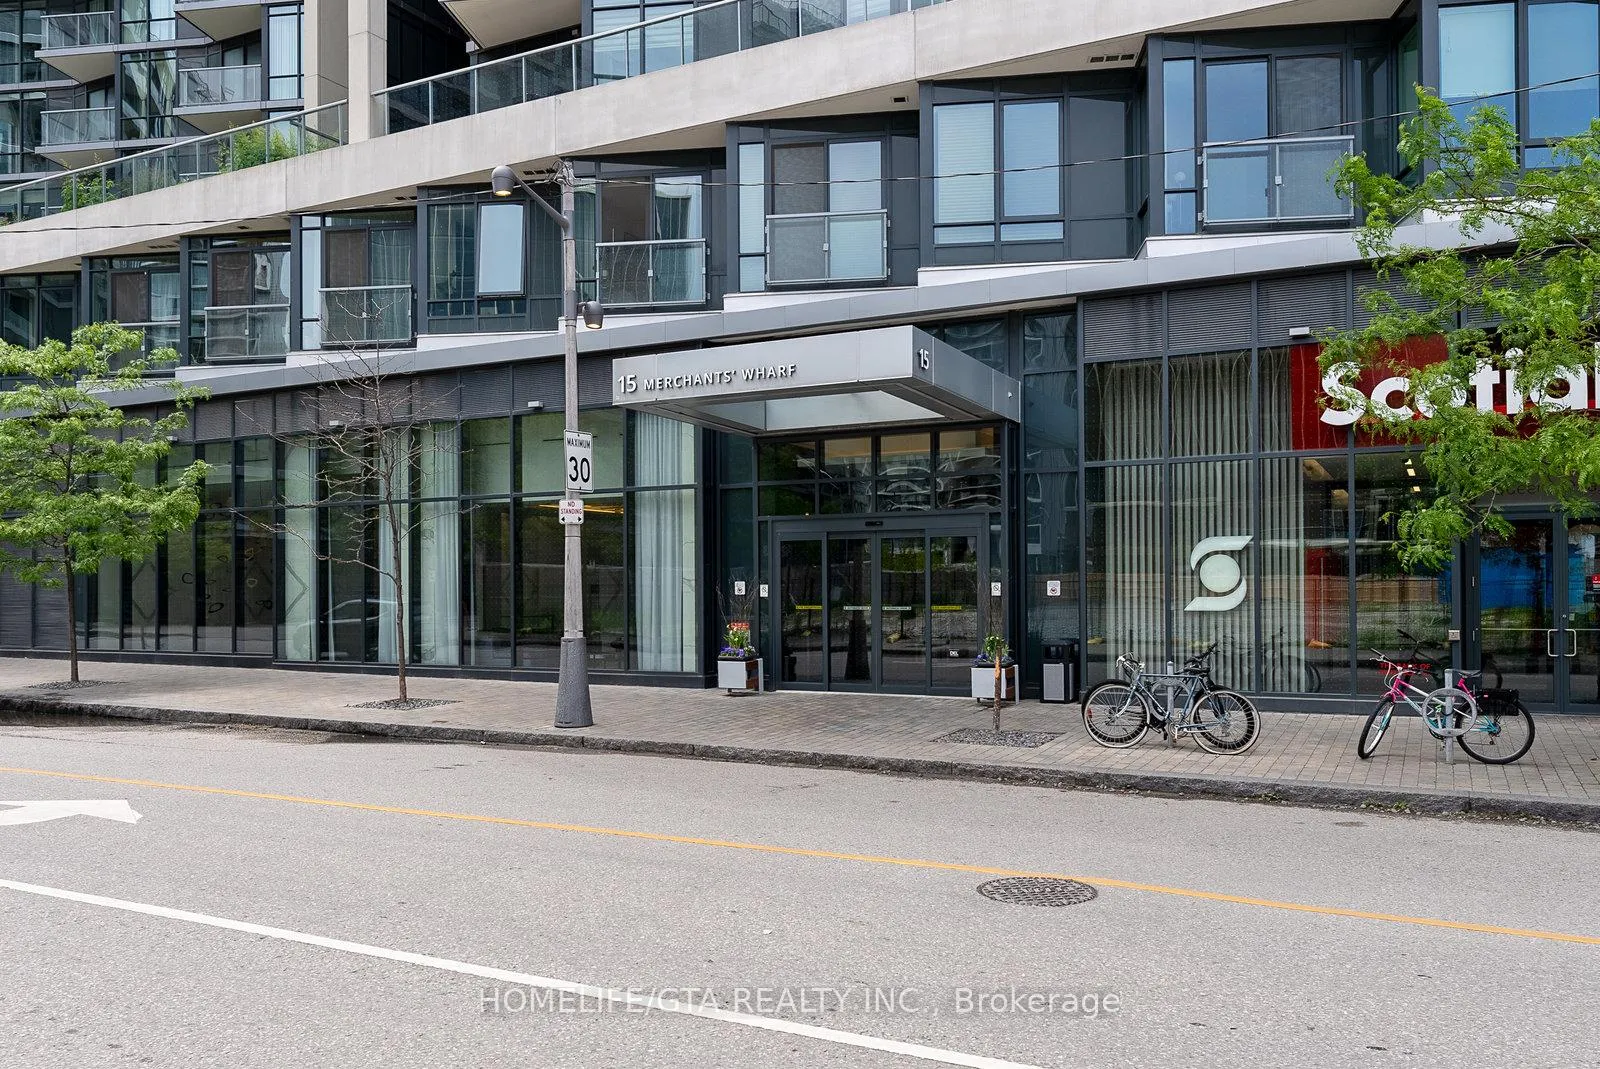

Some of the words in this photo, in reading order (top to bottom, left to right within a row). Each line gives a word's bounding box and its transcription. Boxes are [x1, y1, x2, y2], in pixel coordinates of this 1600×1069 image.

[918, 348, 930, 370] 15
[617, 375, 638, 394] 15
[741, 364, 797, 382] WHARF
[566, 437, 591, 449] MAXIMUM
[568, 456, 590, 483] 30
